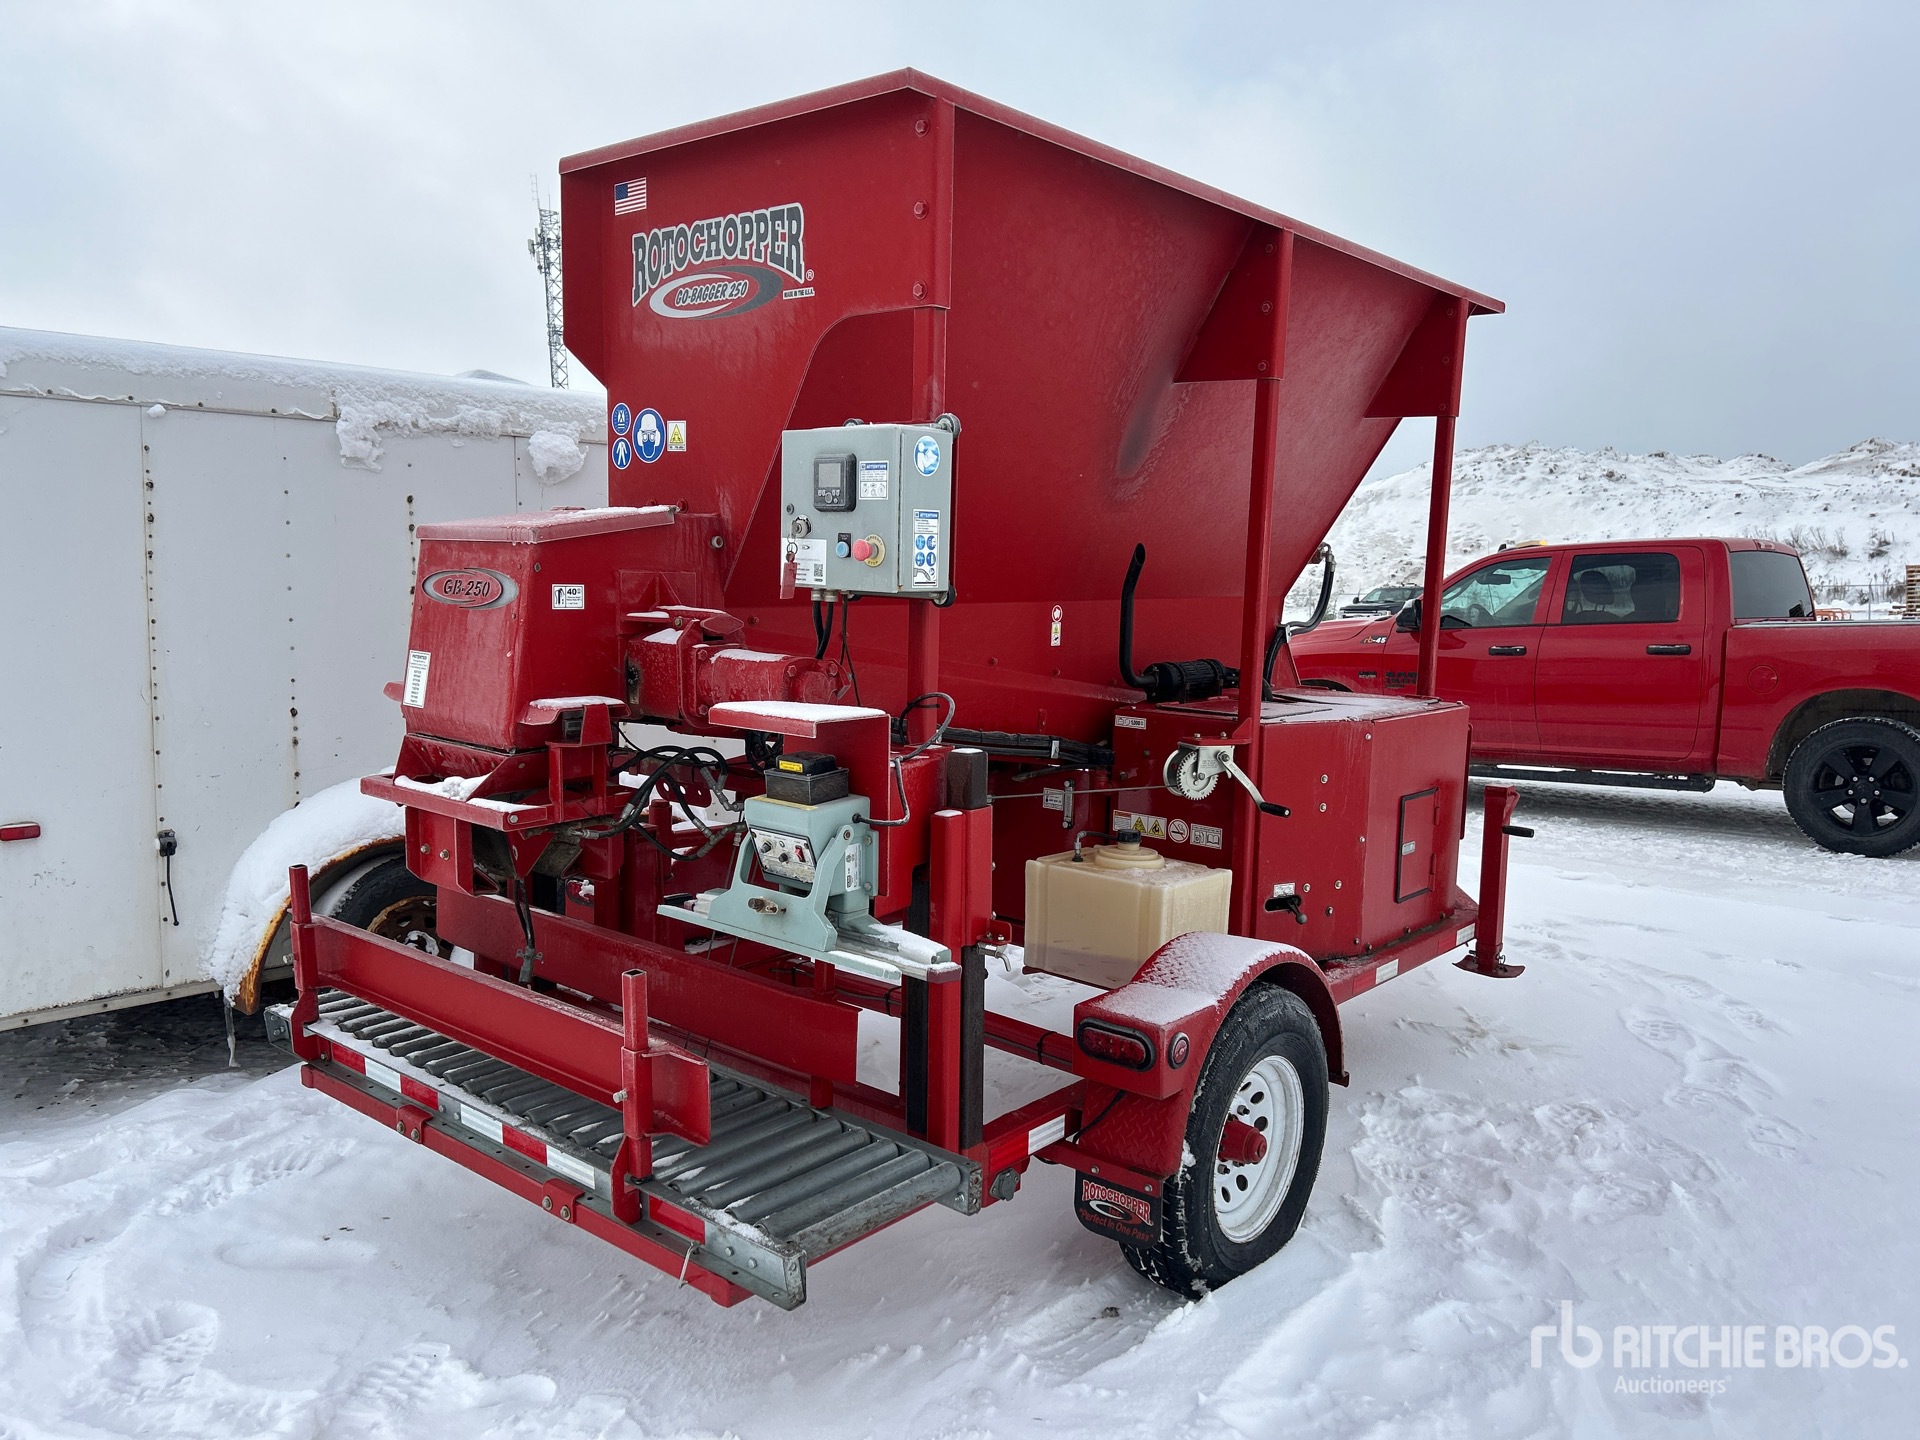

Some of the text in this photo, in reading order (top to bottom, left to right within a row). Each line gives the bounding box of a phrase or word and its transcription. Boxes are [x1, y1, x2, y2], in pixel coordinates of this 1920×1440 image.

[632, 202, 805, 307] ROTOCHOPPER
[675, 280, 749, 306] GO-BAGGER 250
[443, 578, 491, 598] GB-250
[567, 588, 577, 596] 40
[1363, 636, 1387, 644] rb-45
[1082, 1179, 1153, 1227] ROTOCHOPPER
[1108, 1219, 1115, 1229] In
[1115, 1222, 1131, 1235] One
